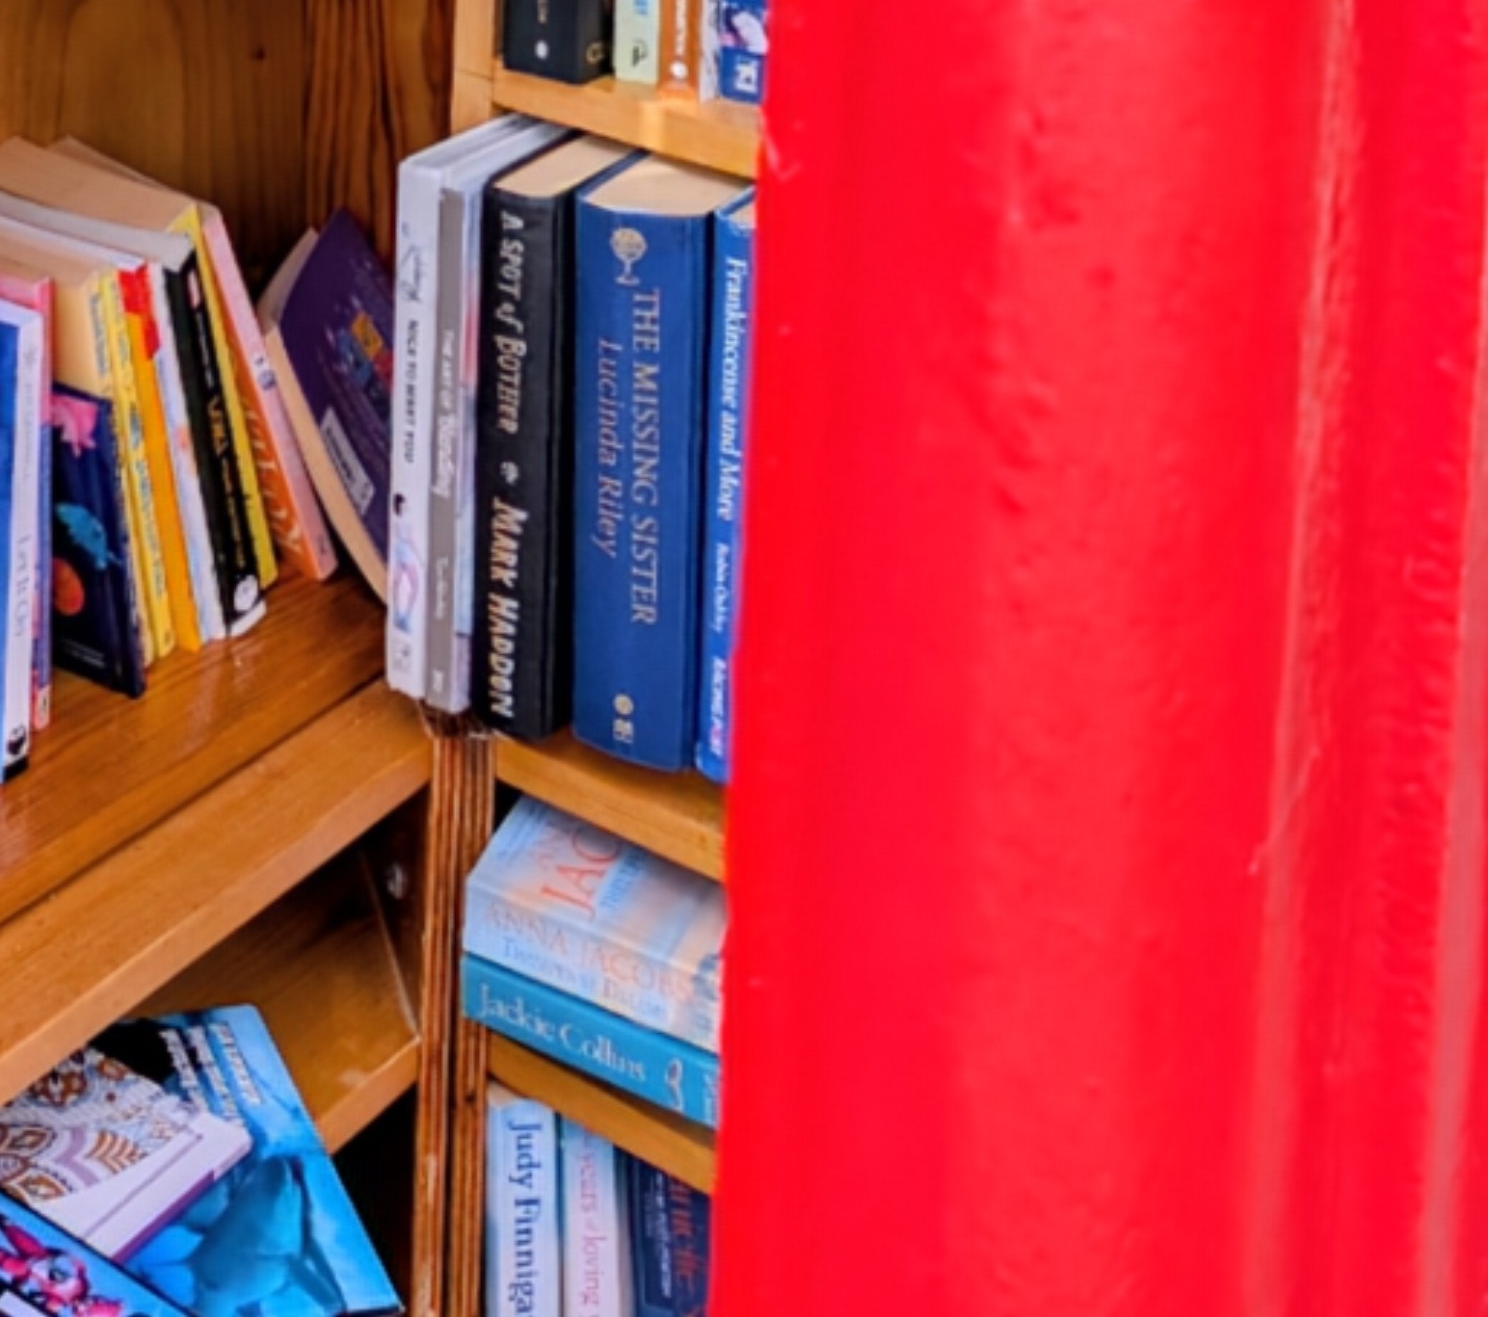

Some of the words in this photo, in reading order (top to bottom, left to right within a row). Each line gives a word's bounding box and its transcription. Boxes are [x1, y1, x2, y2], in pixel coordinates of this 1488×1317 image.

[498, 210, 524, 231] A
[496, 238, 524, 300] SPOT
[441, 329, 454, 357] THE
[493, 301, 524, 334] of
[631, 287, 659, 353] THE
[716, 257, 747, 409] Frankincense
[437, 388, 452, 410] OF
[438, 359, 453, 388] ART
[493, 336, 525, 435] BOTHER
[595, 338, 622, 466] Lucinda
[429, 412, 456, 499] Blending
[629, 364, 658, 507] MISSING
[715, 411, 740, 454] and
[590, 475, 621, 559] Riley
[715, 460, 737, 521] More
[488, 496, 527, 590] MARK
[628, 516, 657, 625] SISTER
[487, 592, 515, 719] HADDON
[482, 897, 568, 957] ANNA
[580, 940, 694, 1005] JACOBS
[479, 982, 554, 1042] Jackie
[560, 1024, 646, 1083] Collins
[506, 1120, 545, 1190] Judy
[506, 1195, 542, 1317] Finniga
[580, 1235, 607, 1307] loving
